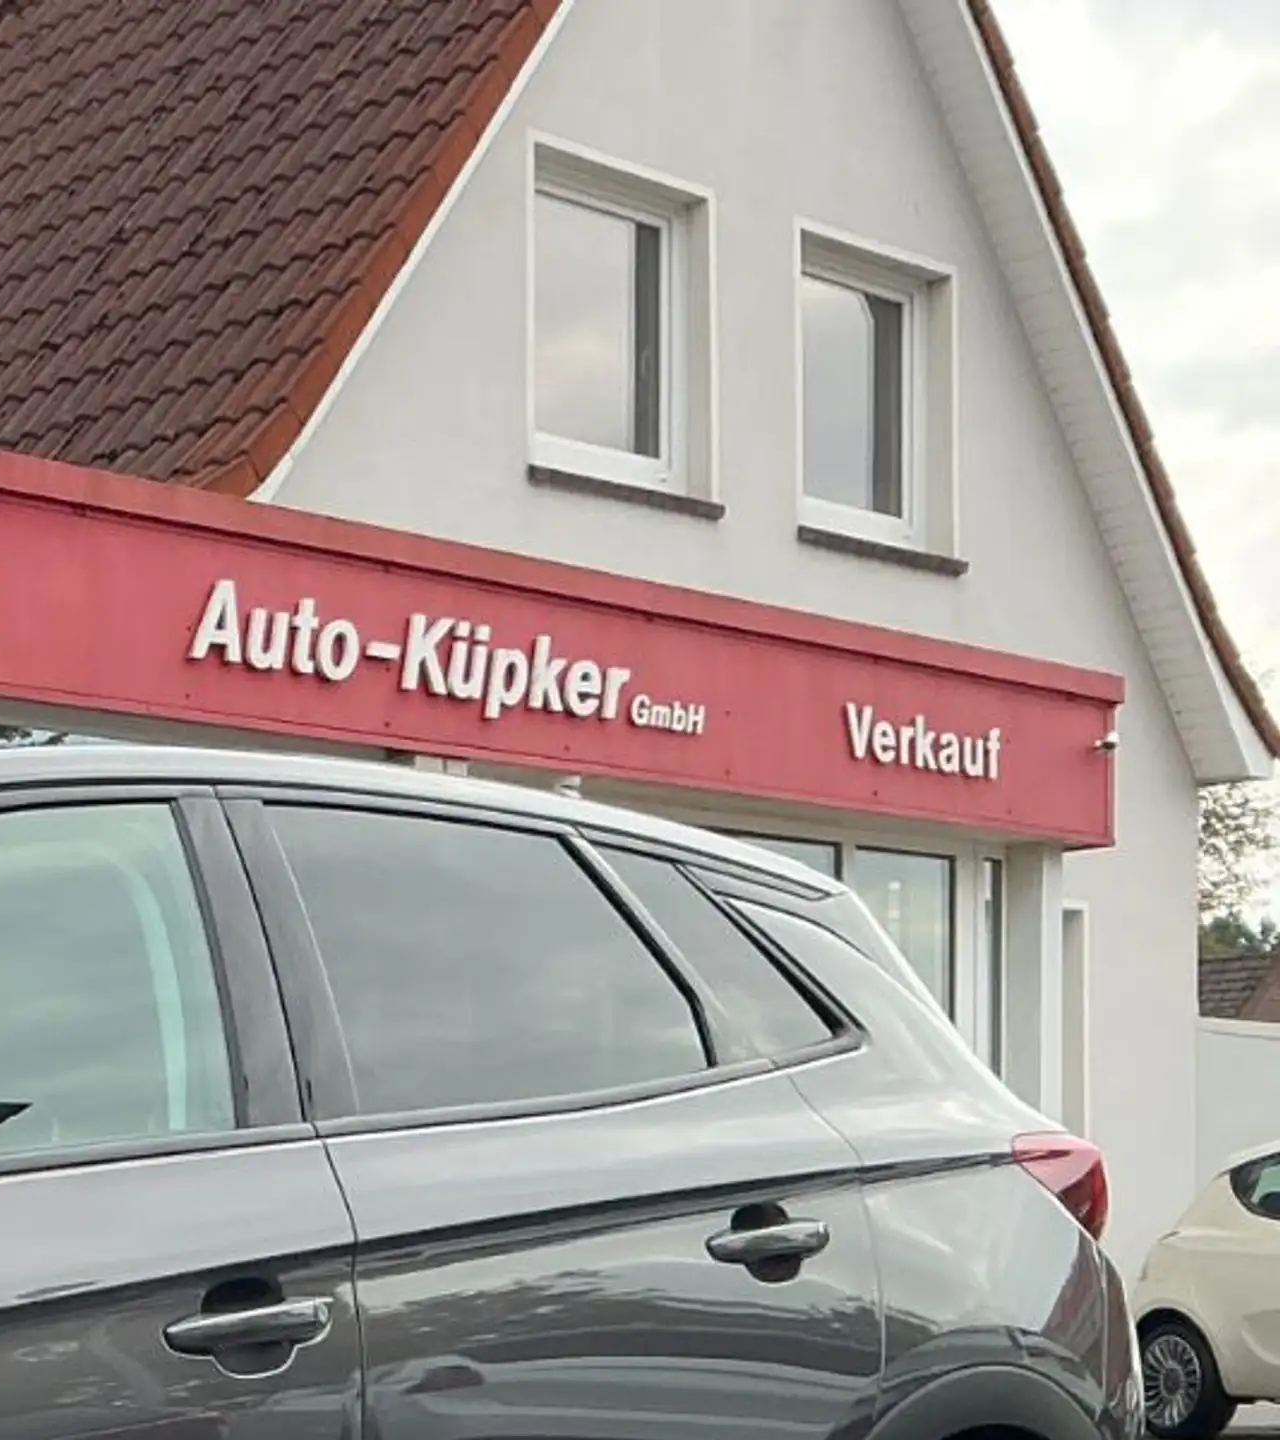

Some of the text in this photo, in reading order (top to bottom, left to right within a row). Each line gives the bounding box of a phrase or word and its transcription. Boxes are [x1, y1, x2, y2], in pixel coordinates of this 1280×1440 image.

[189, 578, 706, 736] Auto-Küpker GmbH
[845, 701, 1002, 782] Verkauf
